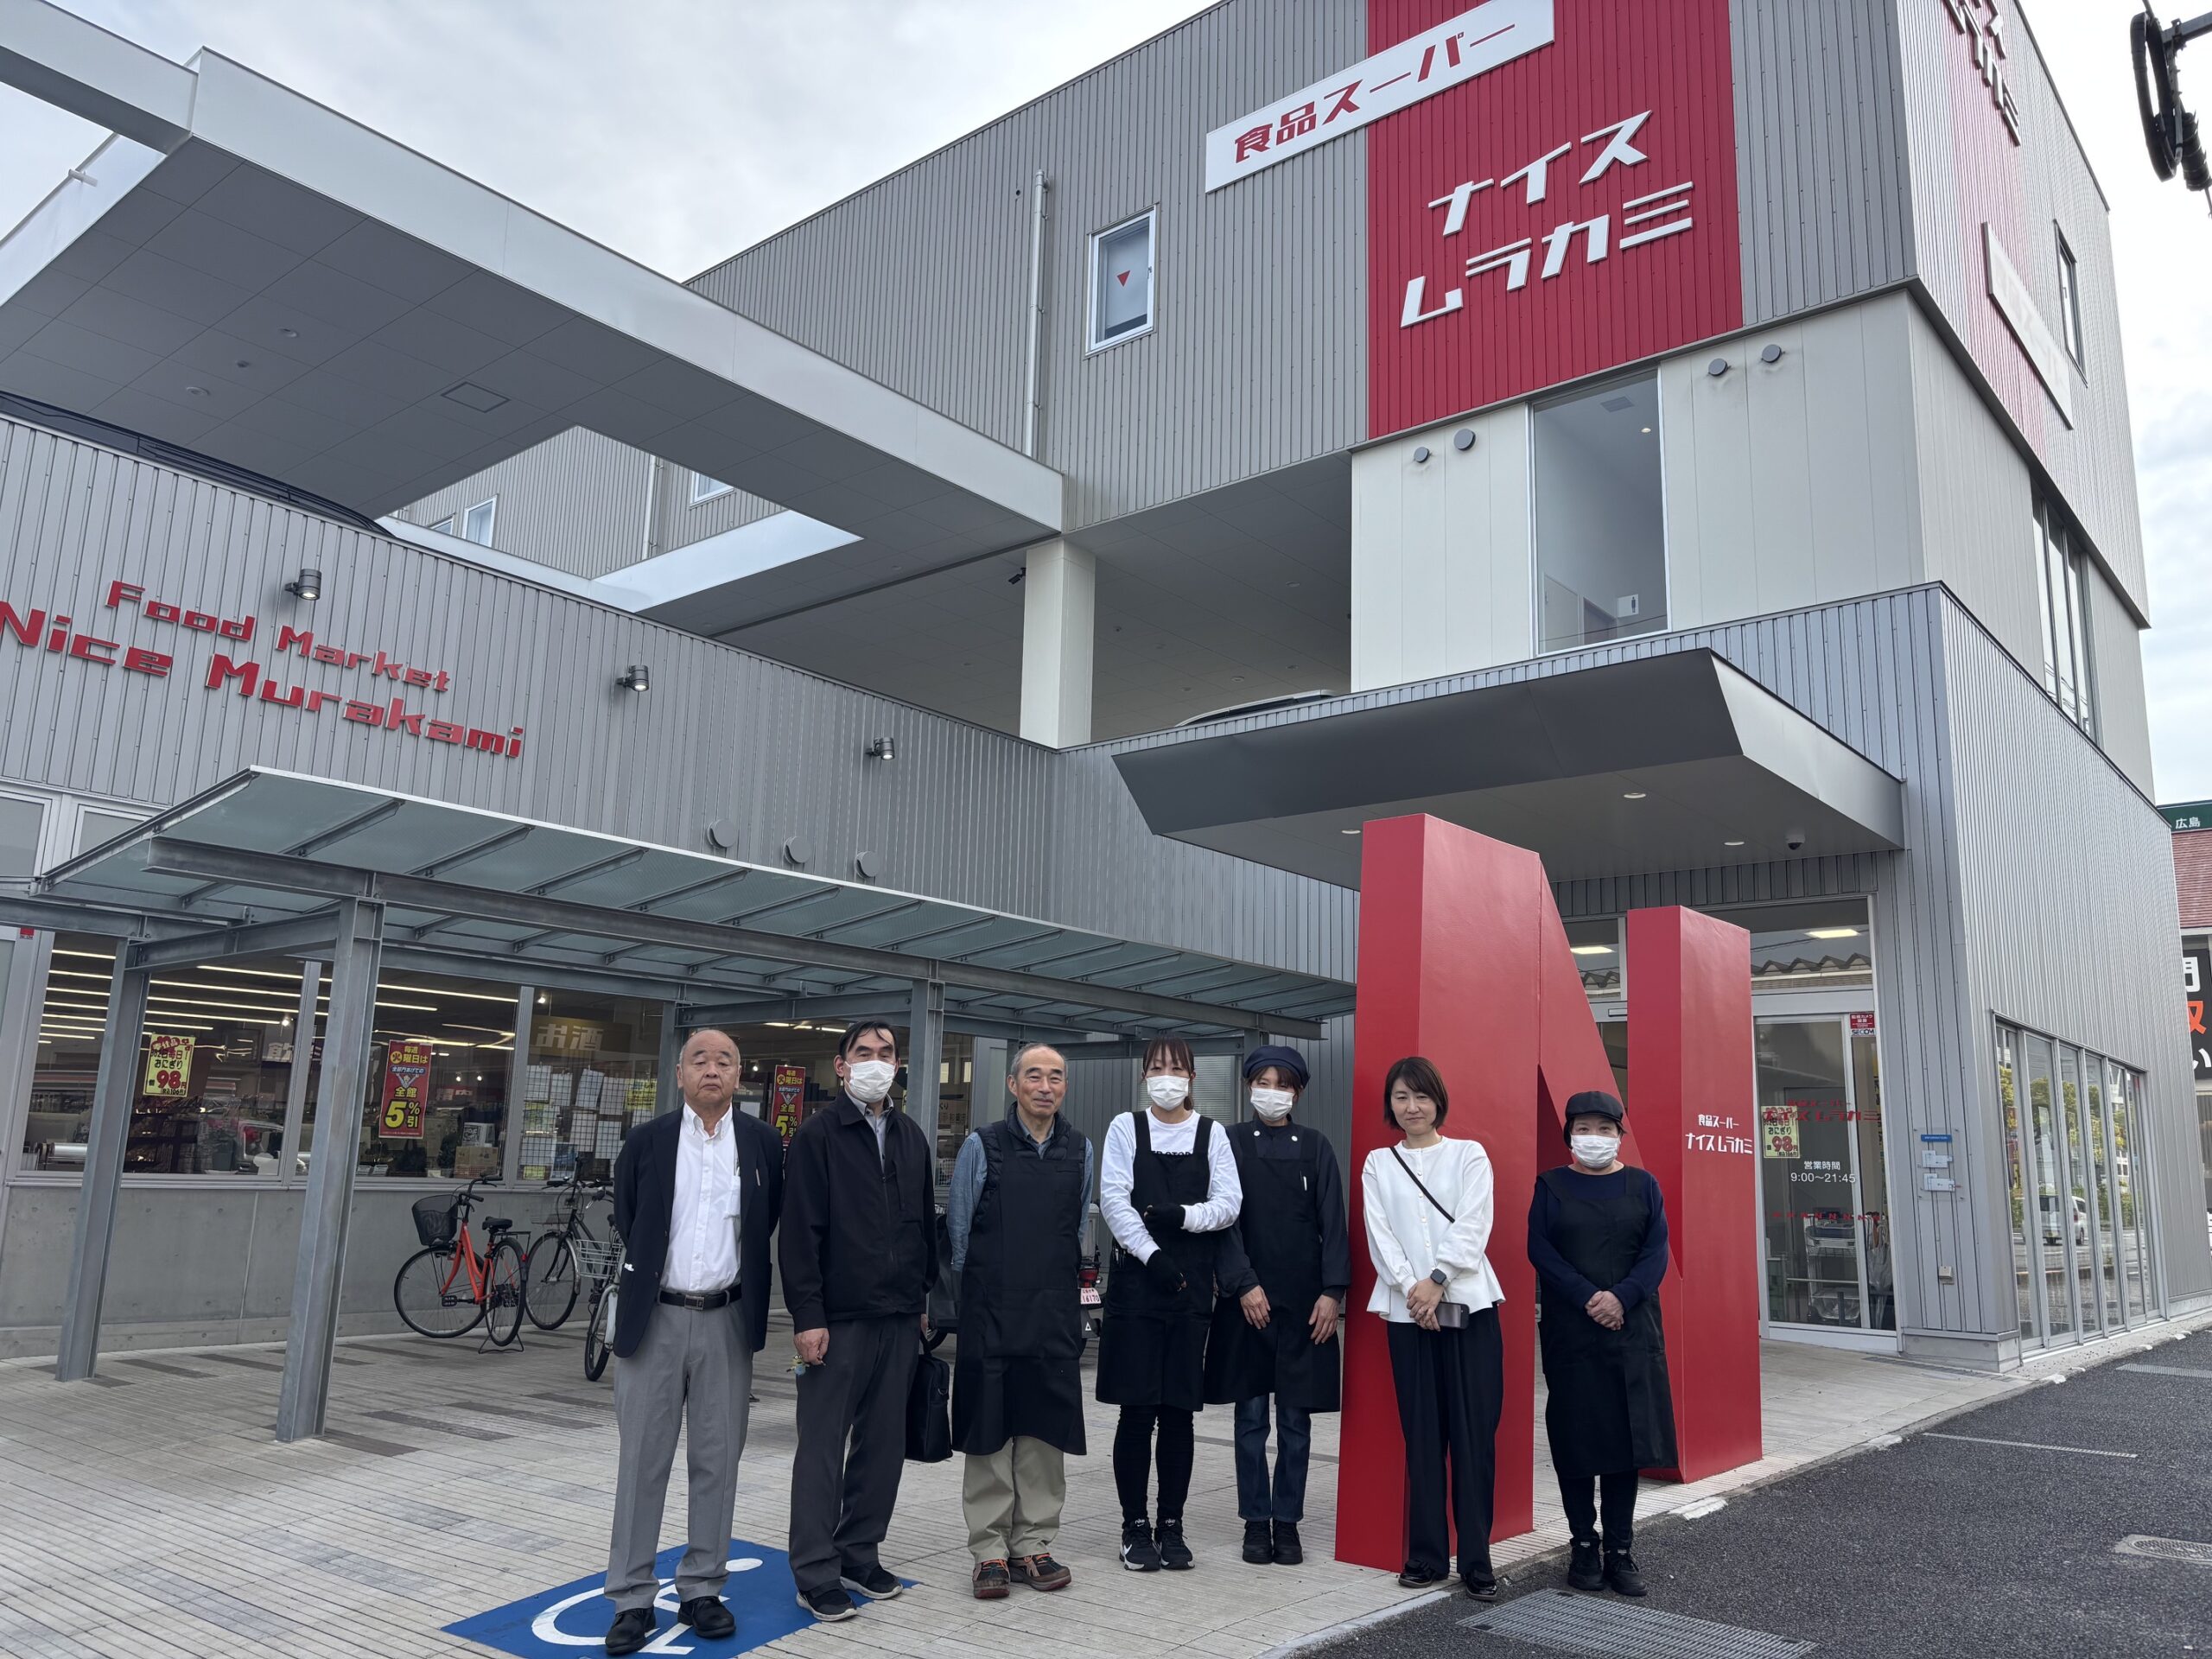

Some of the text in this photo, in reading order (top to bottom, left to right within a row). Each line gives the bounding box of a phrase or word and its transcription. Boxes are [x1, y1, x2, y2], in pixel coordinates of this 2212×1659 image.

[1234, 23, 1516, 164] 食品スーパー
[1427, 110, 1652, 238] ナイス
[1400, 181, 1694, 328] ムラカミ
[105, 579, 451, 693] Food Market
[0, 600, 524, 759] Nice Murakami
[2175, 817, 2201, 830] 広島
[536, 1022, 604, 1052] お酒
[154, 1059, 183, 1070] おにぎり
[391, 1051, 429, 1065] 火曜日は
[395, 1087, 418, 1098] 全館
[1698, 1114, 1739, 1129] 食品スーパー
[1803, 1160, 1841, 1170] 営業時間
